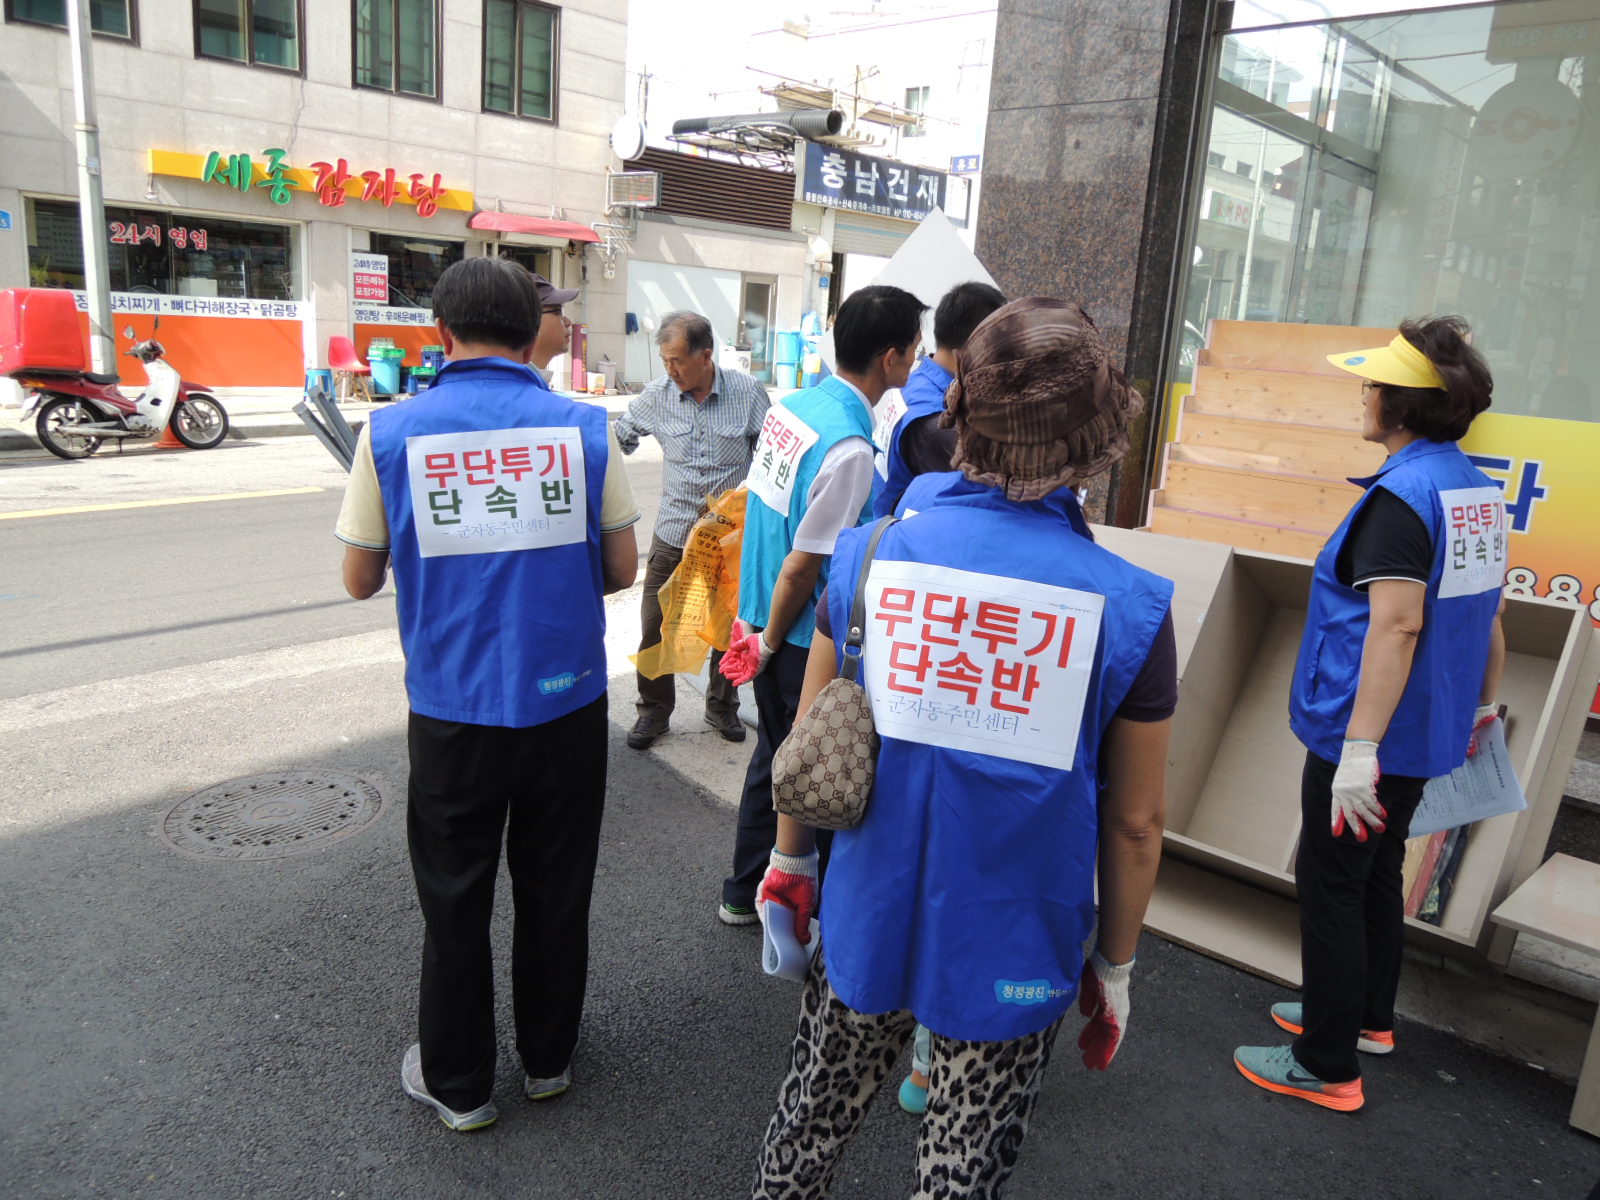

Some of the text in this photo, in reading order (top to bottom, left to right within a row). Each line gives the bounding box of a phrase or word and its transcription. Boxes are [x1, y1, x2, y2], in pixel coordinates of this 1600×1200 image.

[201, 148, 446, 219] 세종 감자탕
[820, 152, 940, 207] 충남건재
[109, 222, 161, 247] 24시
[168, 227, 207, 250] 영업
[170, 299, 251, 316] 뼈다귀해장국
[259, 303, 298, 318] 닭곰탕
[763, 413, 804, 465] 무단투기
[424, 443, 570, 488] 무단투기
[456, 518, 551, 540] 군자동주민센터
[1451, 501, 1503, 537] 무단투기
[875, 587, 1076, 669] 무단투기
[887, 641, 1040, 715] 단속반
[888, 694, 1020, 736] 군자동주민센터
[1002, 985, 1045, 999] 청정광진
